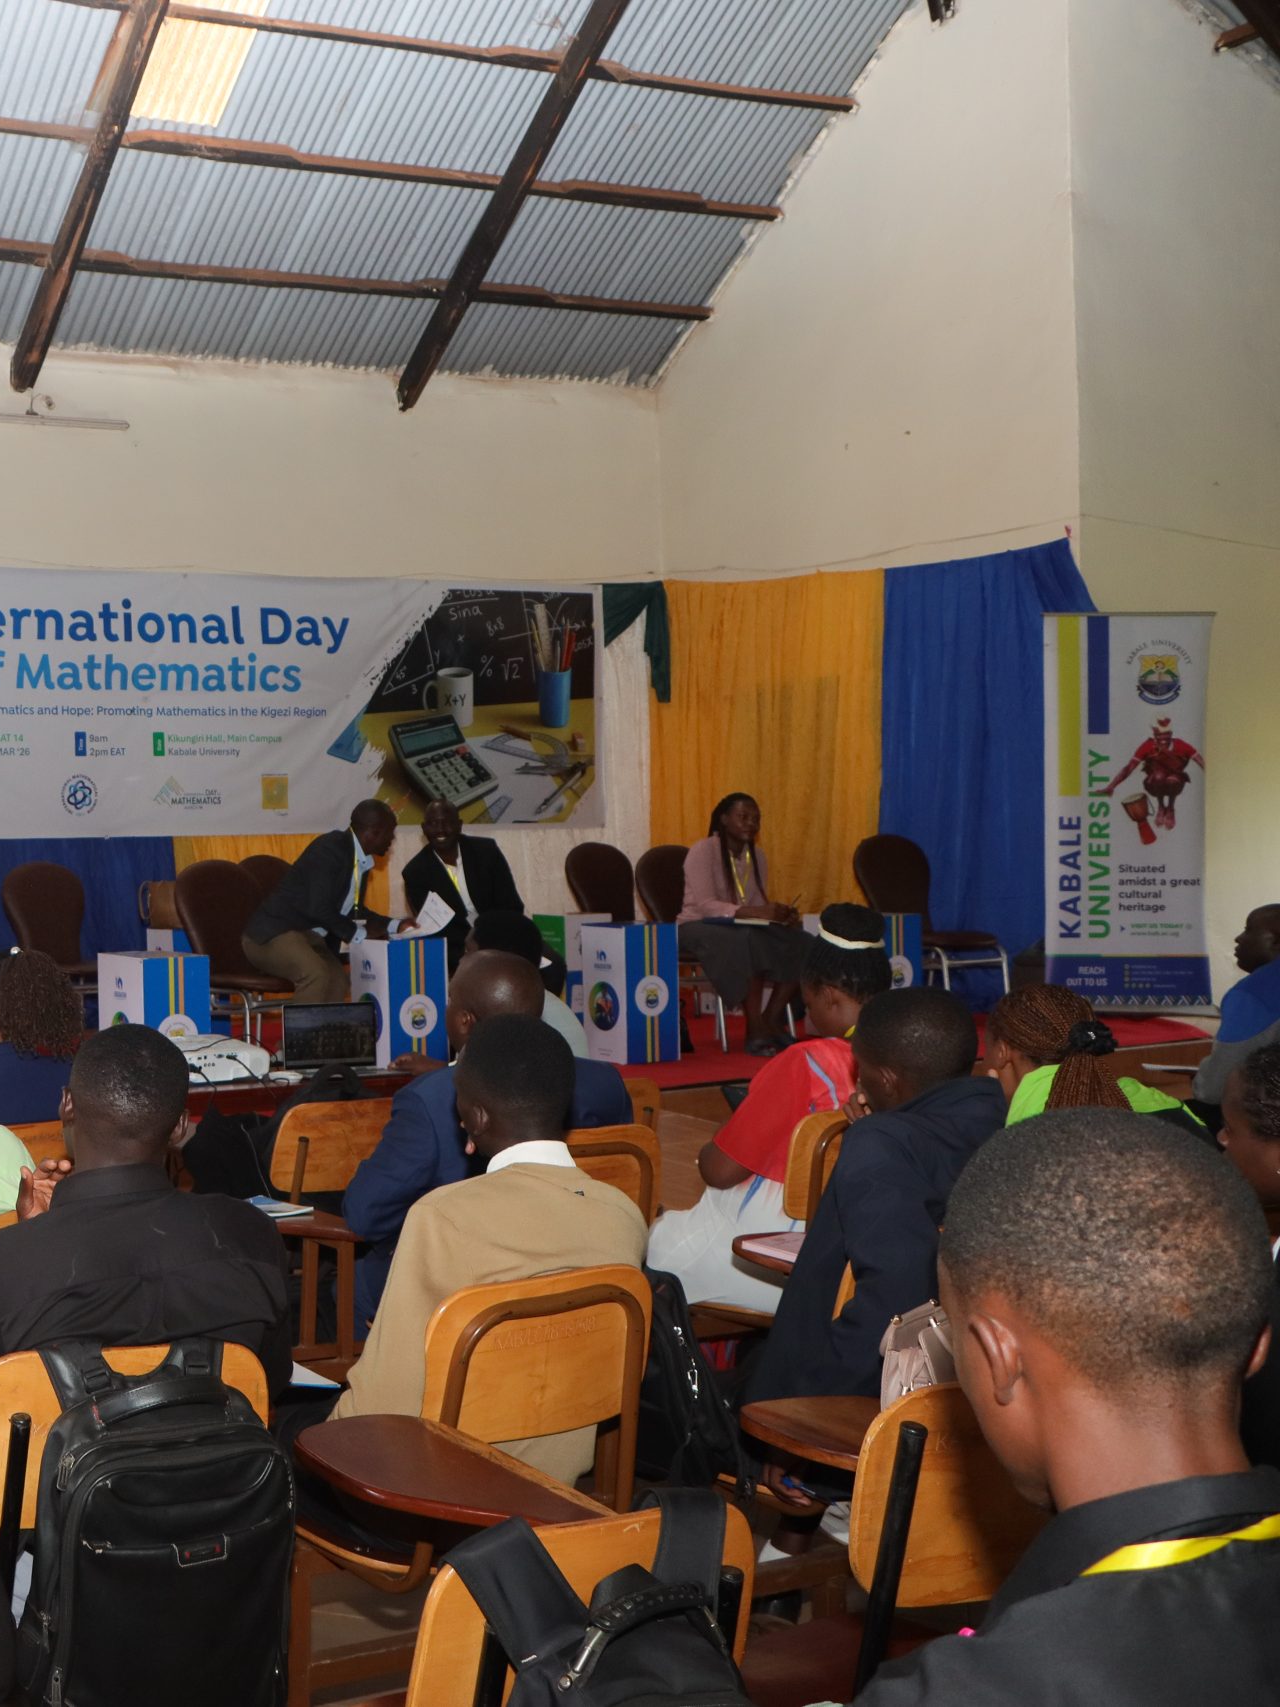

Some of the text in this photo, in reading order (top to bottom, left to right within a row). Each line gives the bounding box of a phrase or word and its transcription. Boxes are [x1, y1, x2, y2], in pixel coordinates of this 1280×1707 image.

[260, 605, 350, 654] Day
[15, 651, 302, 693] Mathematics
[37, 705, 59, 716] and
[61, 705, 94, 718] Hope:
[97, 705, 153, 719] Promoting
[156, 706, 226, 717] Mathematics
[228, 706, 239, 717] in
[241, 706, 258, 717] the
[261, 706, 291, 719] Kigezi
[293, 707, 327, 719] Region
[13, 733, 24, 743] 14
[89, 734, 109, 743] 9am
[168, 733, 282, 745] Kikungiri Hall, Main Campus
[89, 747, 126, 758] 2pm EAT
[168, 747, 240, 758] Kabale University
[205, 788, 218, 796] DAY
[171, 796, 222, 806] MATHEMATICS
[1087, 748, 1111, 939] UNIVERSITY
[1118, 863, 1166, 873] Situated
[1058, 815, 1082, 939] KABALE
[1118, 876, 1201, 888] amidst a great
[1118, 889, 1162, 900] cultural
[1118, 902, 1166, 914] heritage
[1078, 966, 1106, 975] REACH
[1066, 977, 1108, 987] OUT TO US
